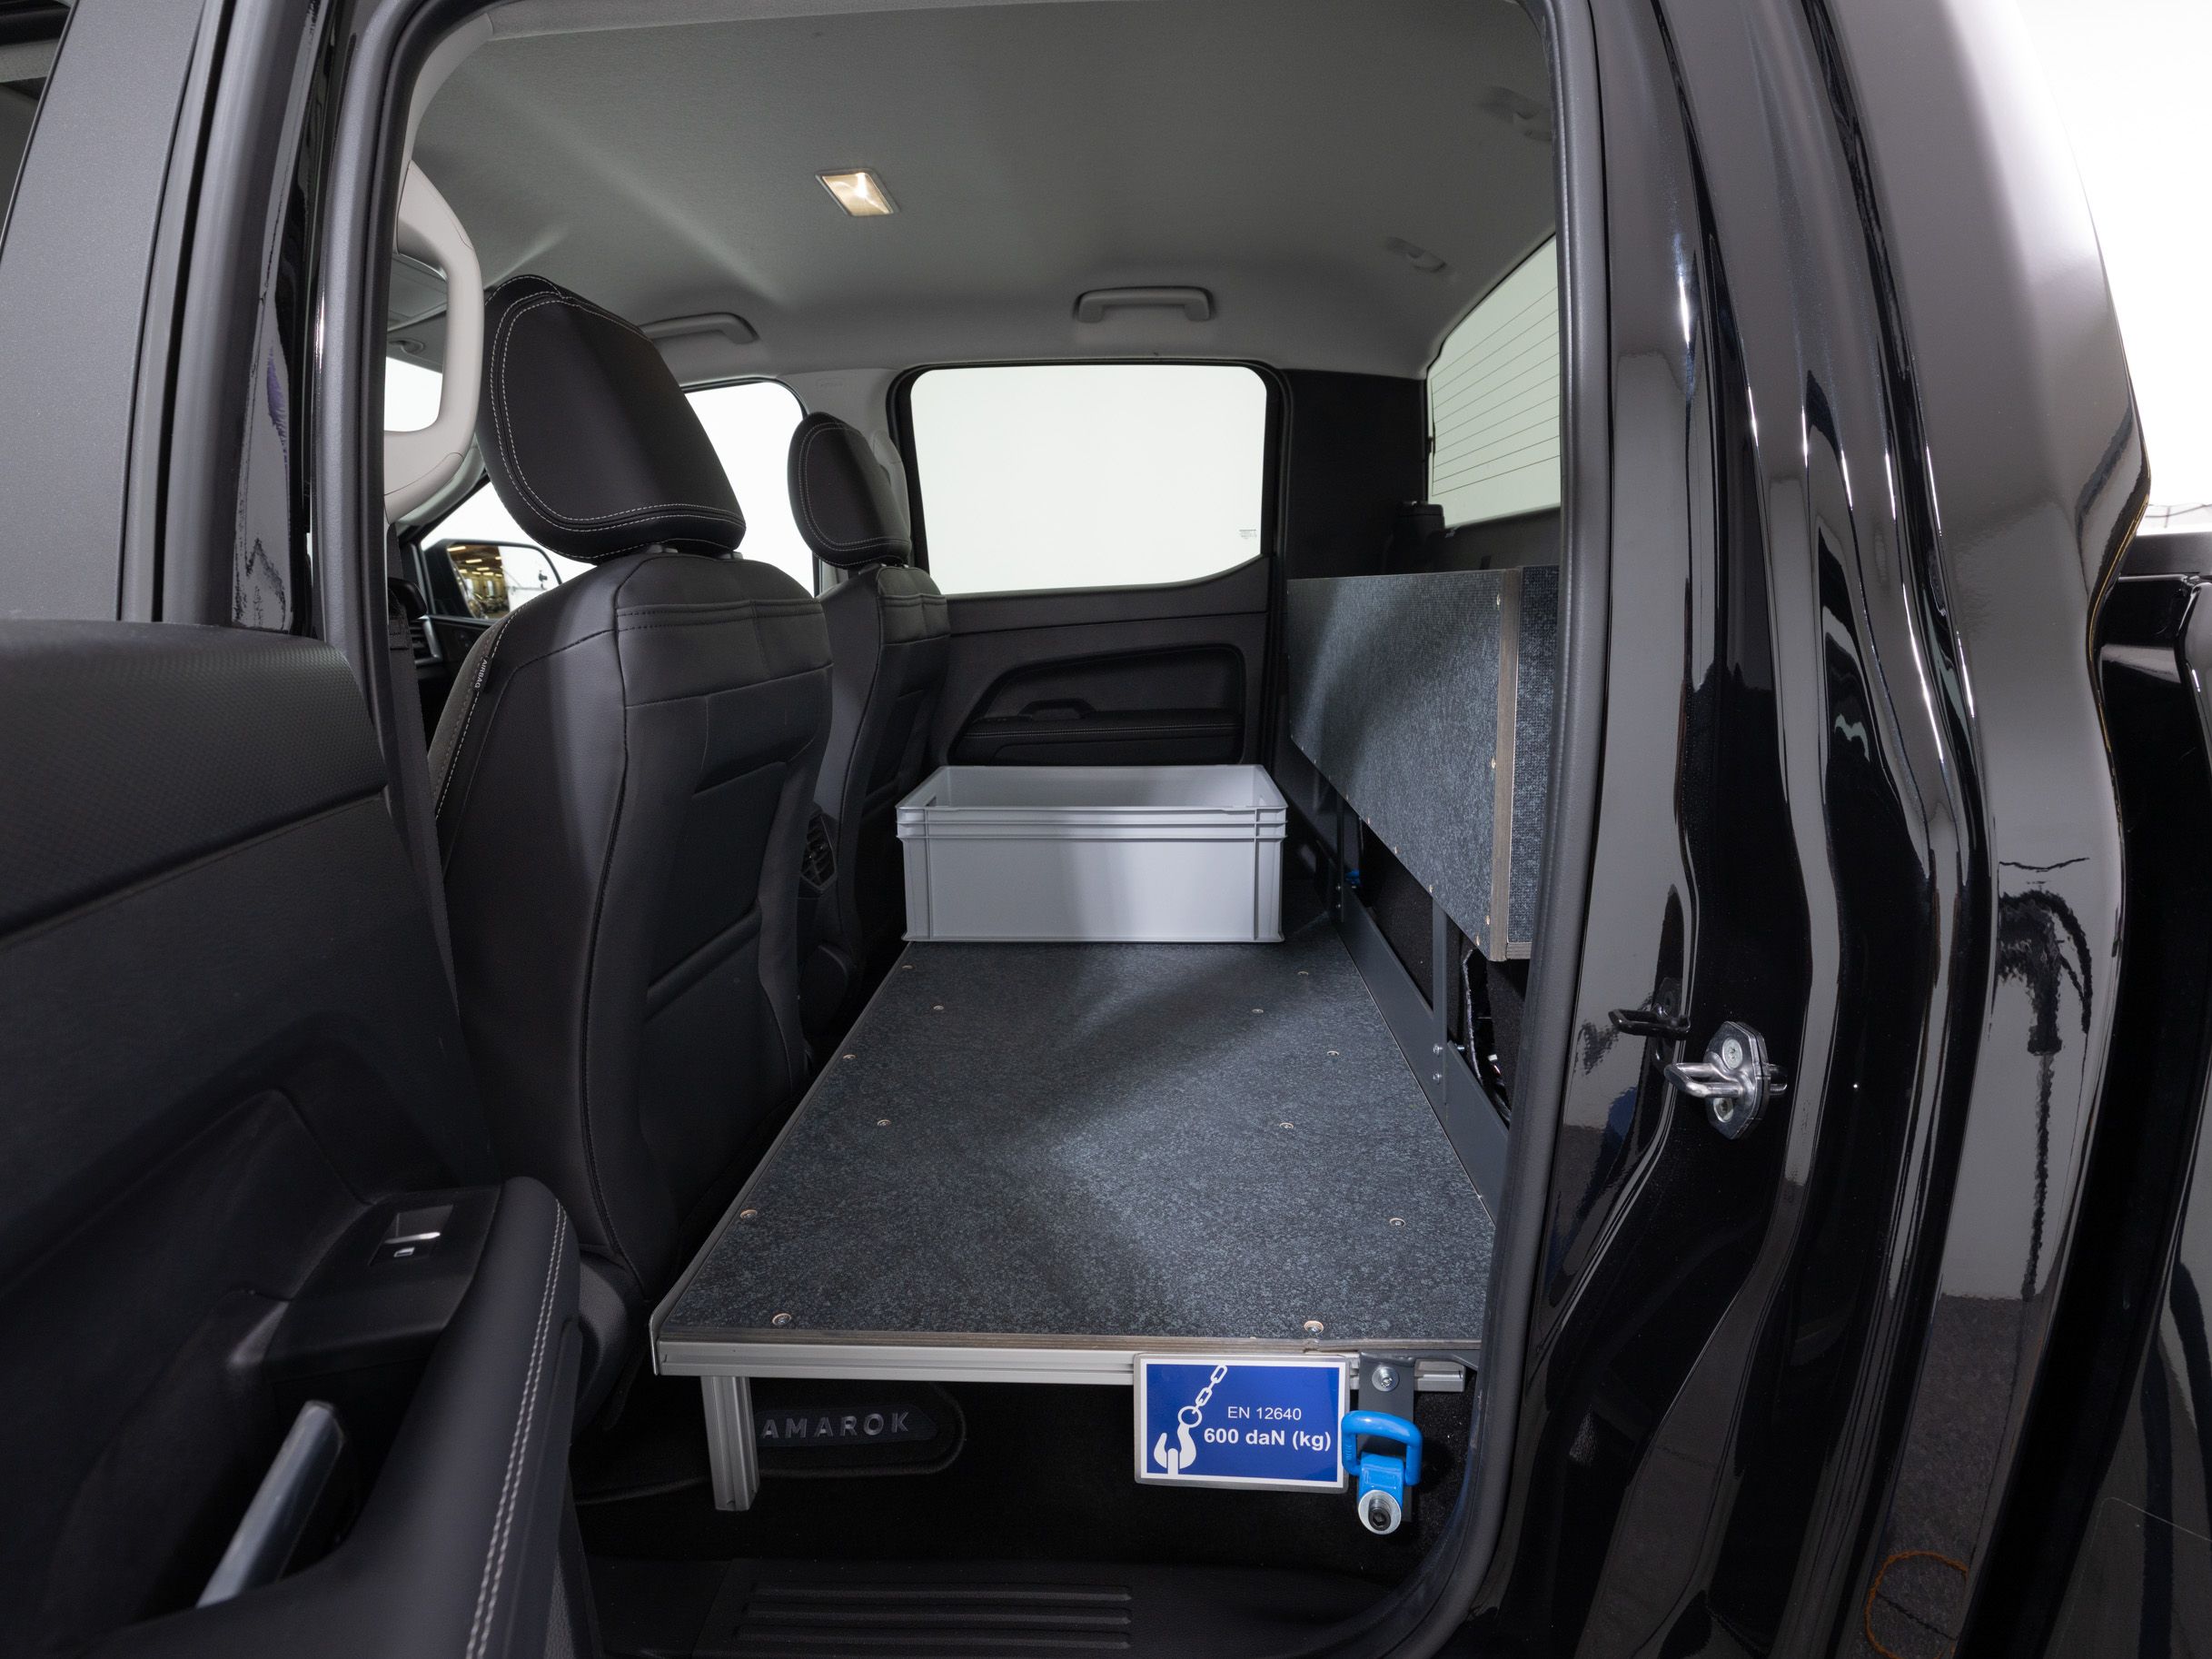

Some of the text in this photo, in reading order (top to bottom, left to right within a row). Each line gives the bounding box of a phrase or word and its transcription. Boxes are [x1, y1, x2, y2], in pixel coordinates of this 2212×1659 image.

[474, 659, 488, 689] AIRBAG
[762, 1412, 909, 1439] AMAROK
[1227, 1406, 1302, 1421] EN 12640
[1204, 1427, 1239, 1445] 600
[1245, 1429, 1285, 1446] daN
[1292, 1430, 1332, 1452] (kg)
